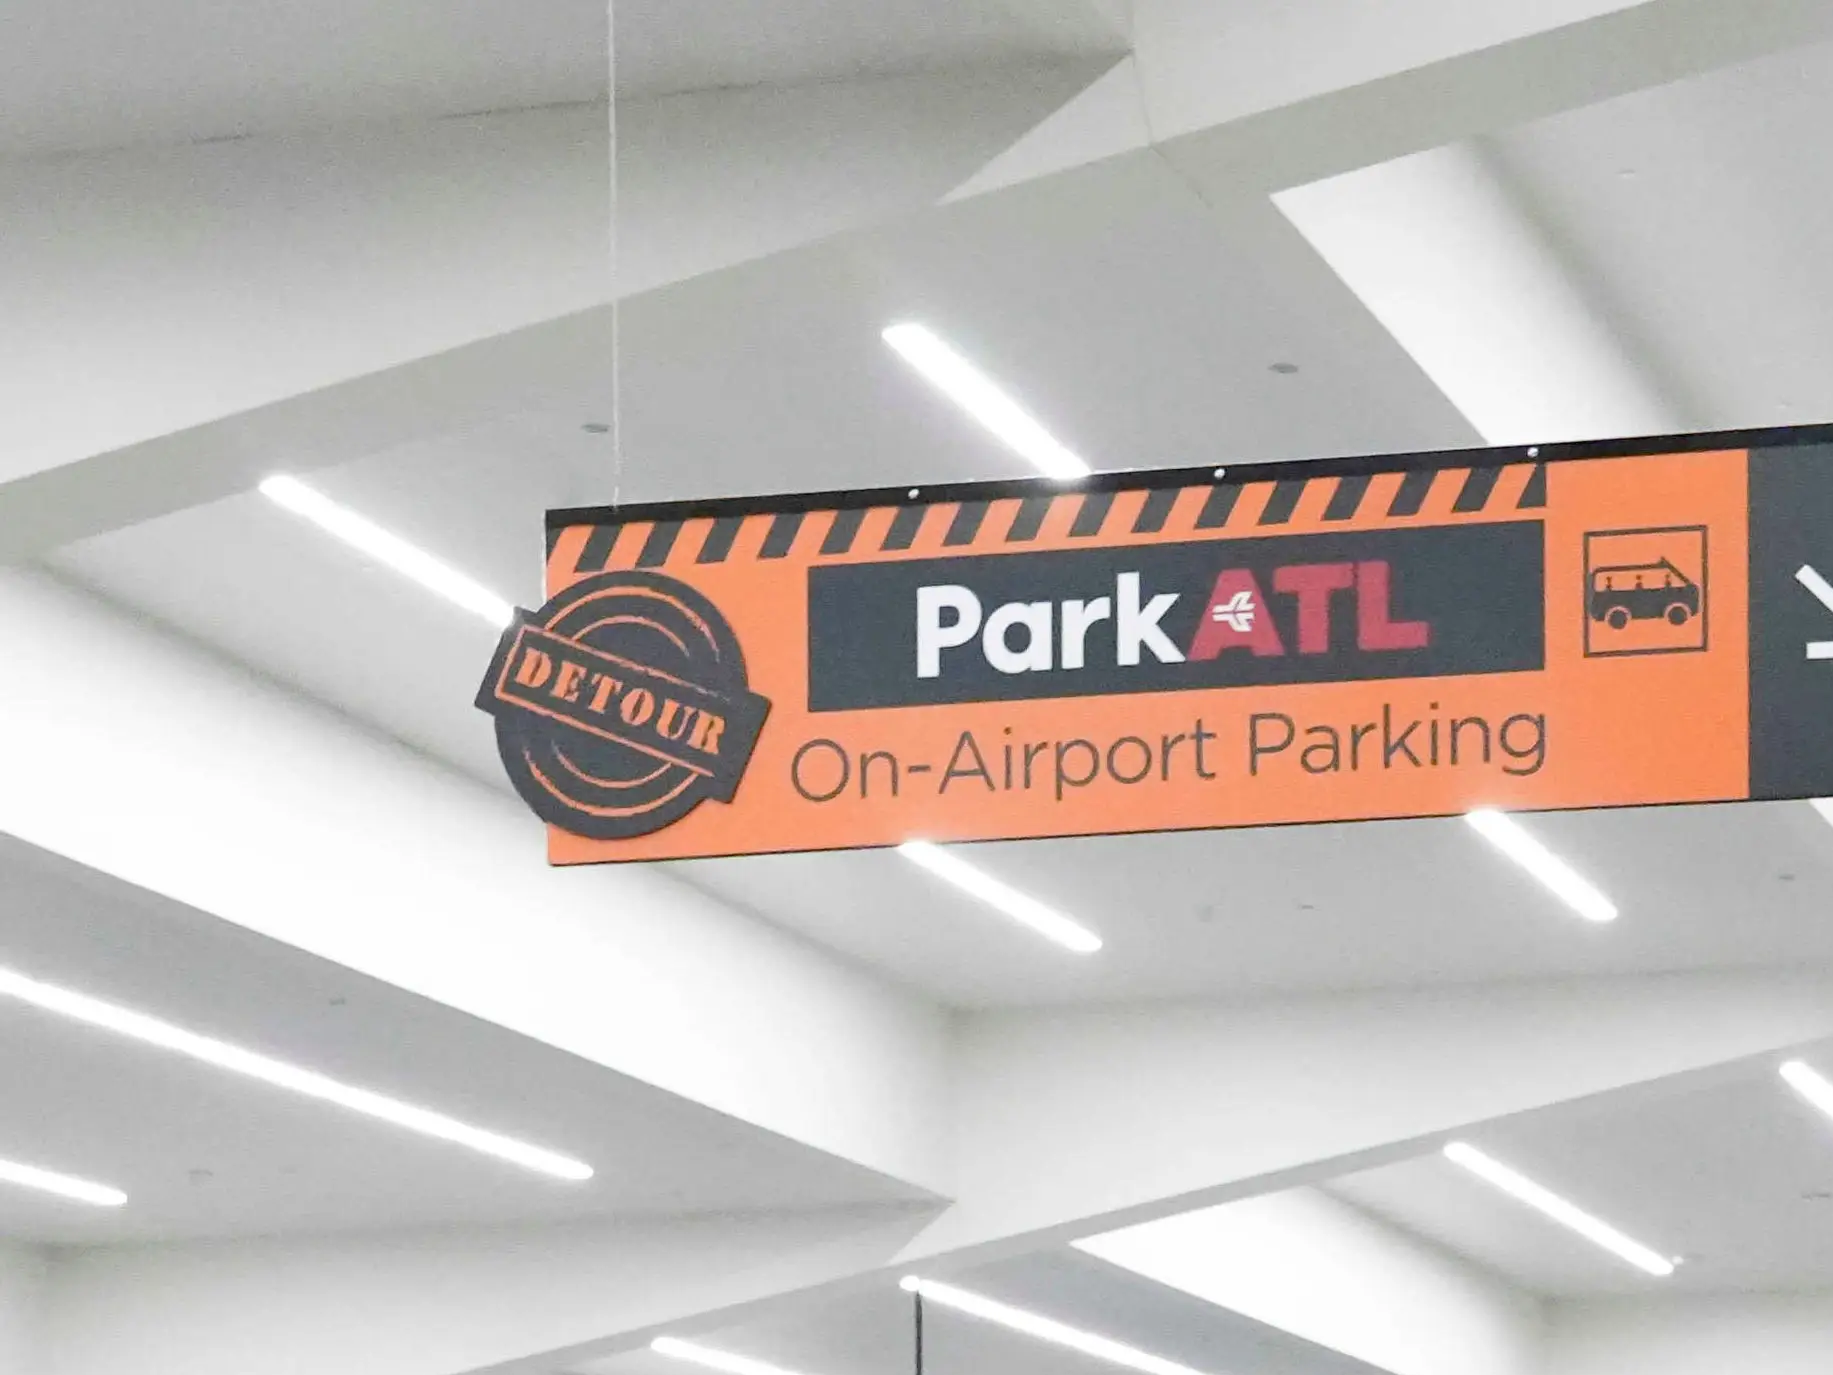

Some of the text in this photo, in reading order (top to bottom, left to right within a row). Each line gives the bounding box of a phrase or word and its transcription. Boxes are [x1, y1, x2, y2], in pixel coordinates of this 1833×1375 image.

[915, 560, 1431, 680] ParkATL
[513, 647, 726, 756] DETOUR
[790, 702, 1547, 804] On-Airport Parking
